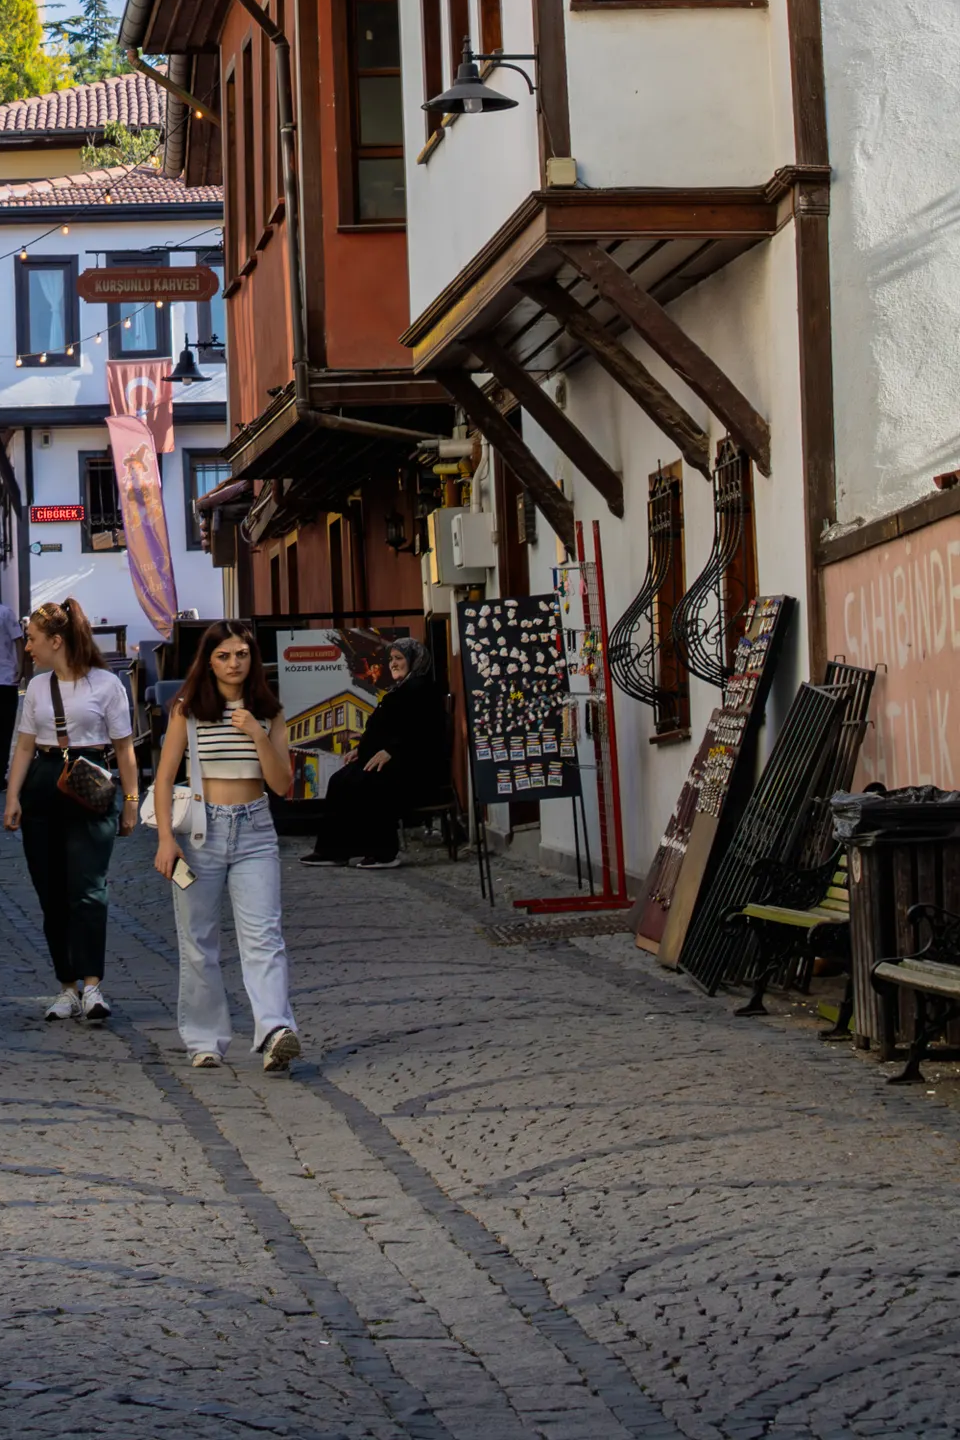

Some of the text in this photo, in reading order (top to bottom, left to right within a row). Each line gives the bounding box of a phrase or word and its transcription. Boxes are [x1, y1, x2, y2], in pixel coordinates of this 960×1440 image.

[94, 274, 200, 294] KURŞUNLU KAHVESİ
[285, 663, 342, 672] KÖZDE KAHVE
